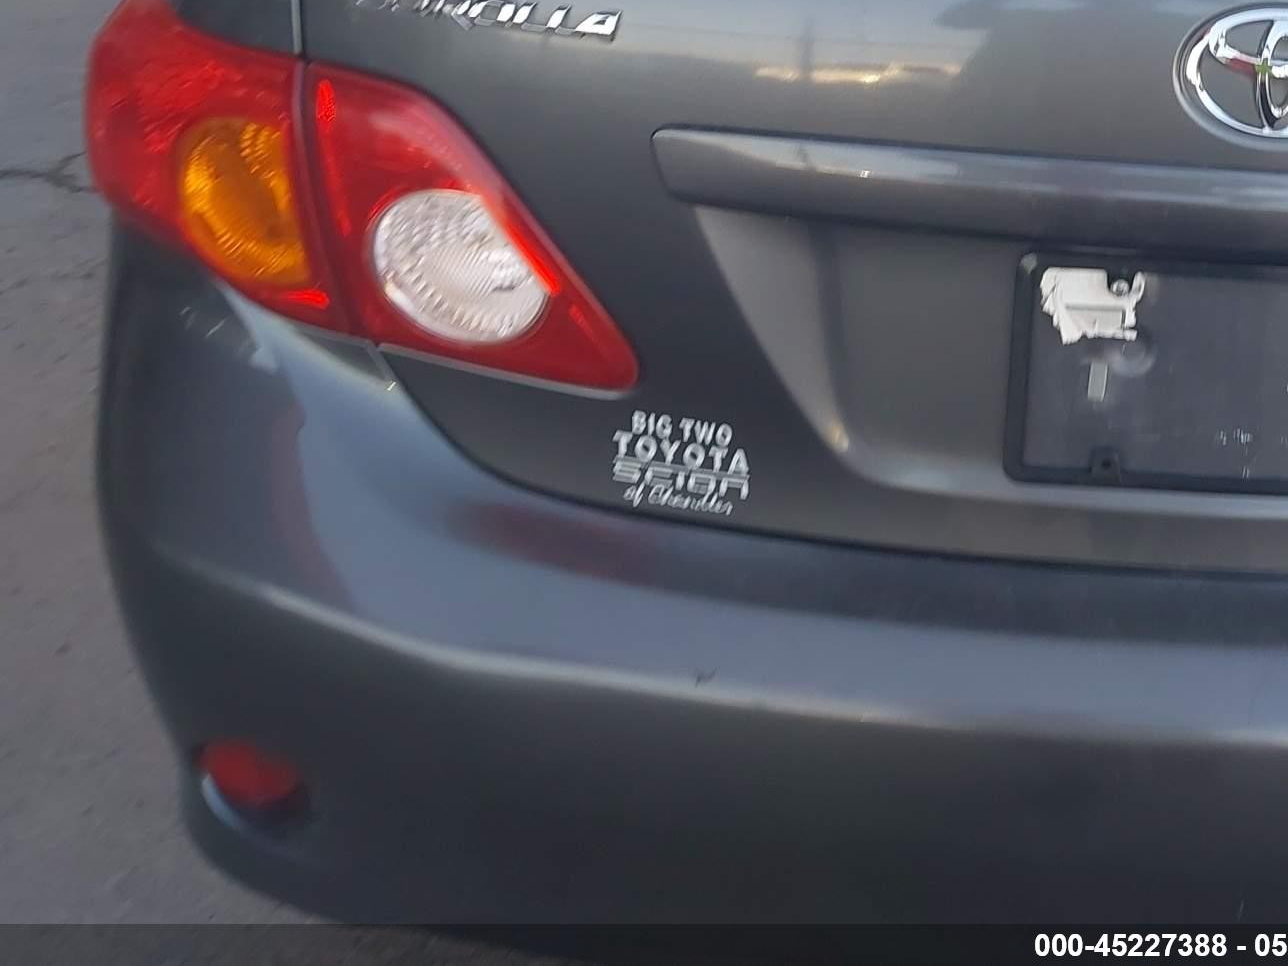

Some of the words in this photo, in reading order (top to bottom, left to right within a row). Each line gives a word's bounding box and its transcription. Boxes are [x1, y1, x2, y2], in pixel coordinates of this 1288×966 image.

[632, 410, 672, 439] BIG
[679, 418, 732, 447] TWO
[612, 430, 749, 474] TOYOTA
